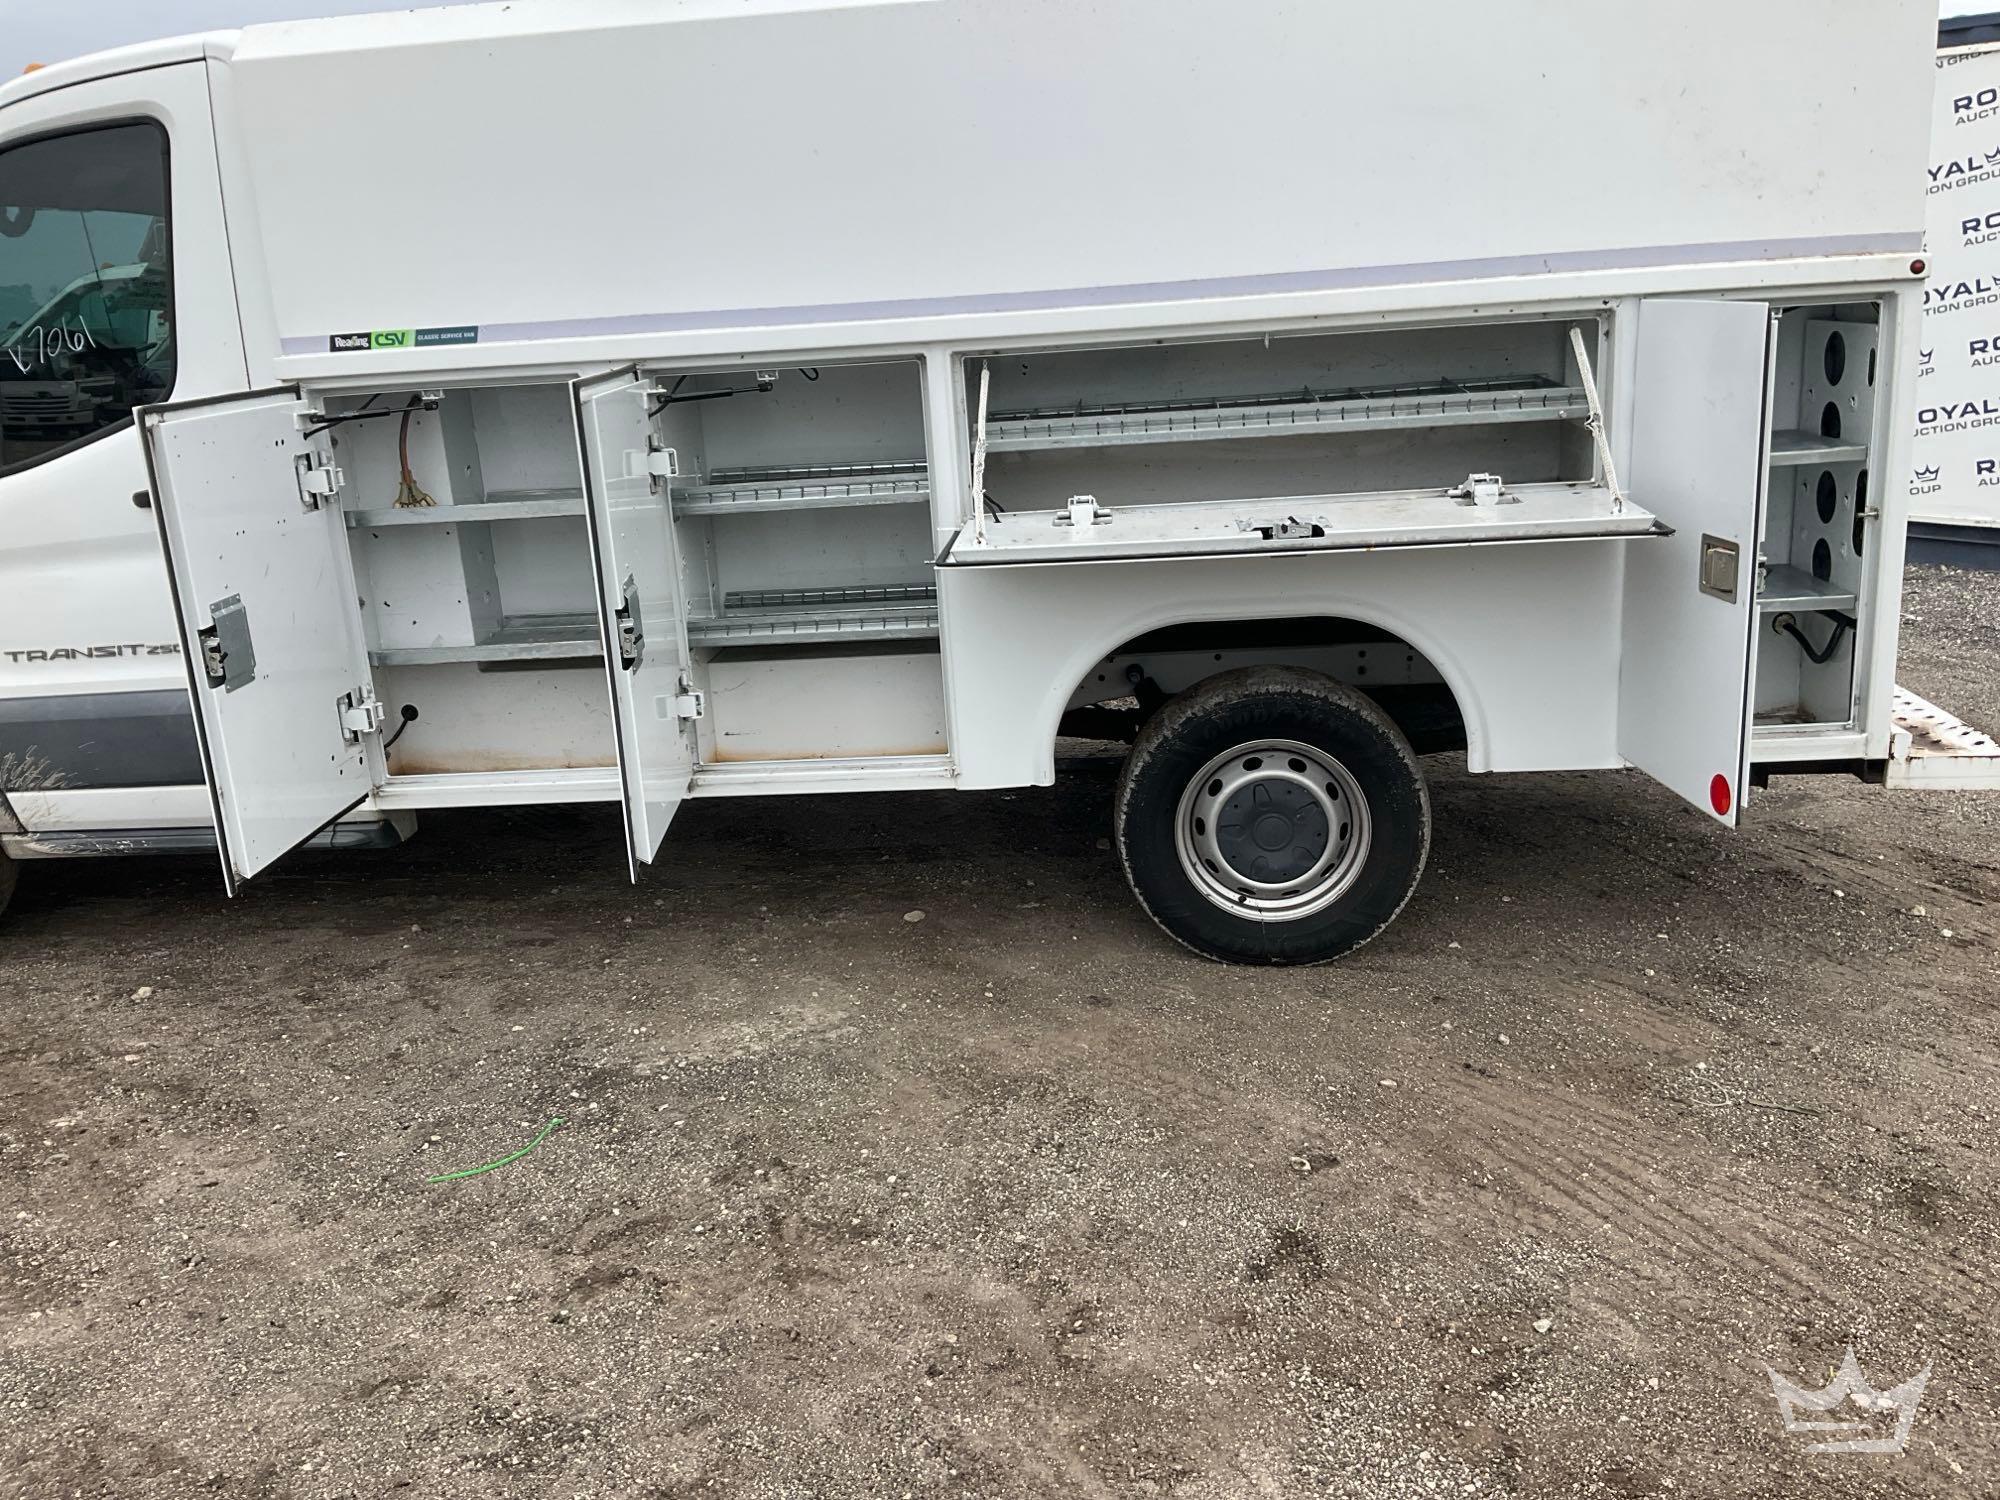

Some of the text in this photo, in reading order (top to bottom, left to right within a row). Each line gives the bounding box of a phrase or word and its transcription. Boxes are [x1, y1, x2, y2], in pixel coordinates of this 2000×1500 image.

[1953, 86, 2000, 114] RO
[1955, 105, 1999, 126] AUCT
[1927, 156, 1984, 182] YAL
[1963, 231, 2000, 247] AUC
[1964, 293, 2000, 308] GRO
[375, 332, 405, 346] CSV
[1918, 399, 1999, 424] OYAL
[4, 643, 145, 663] TRANSIT
